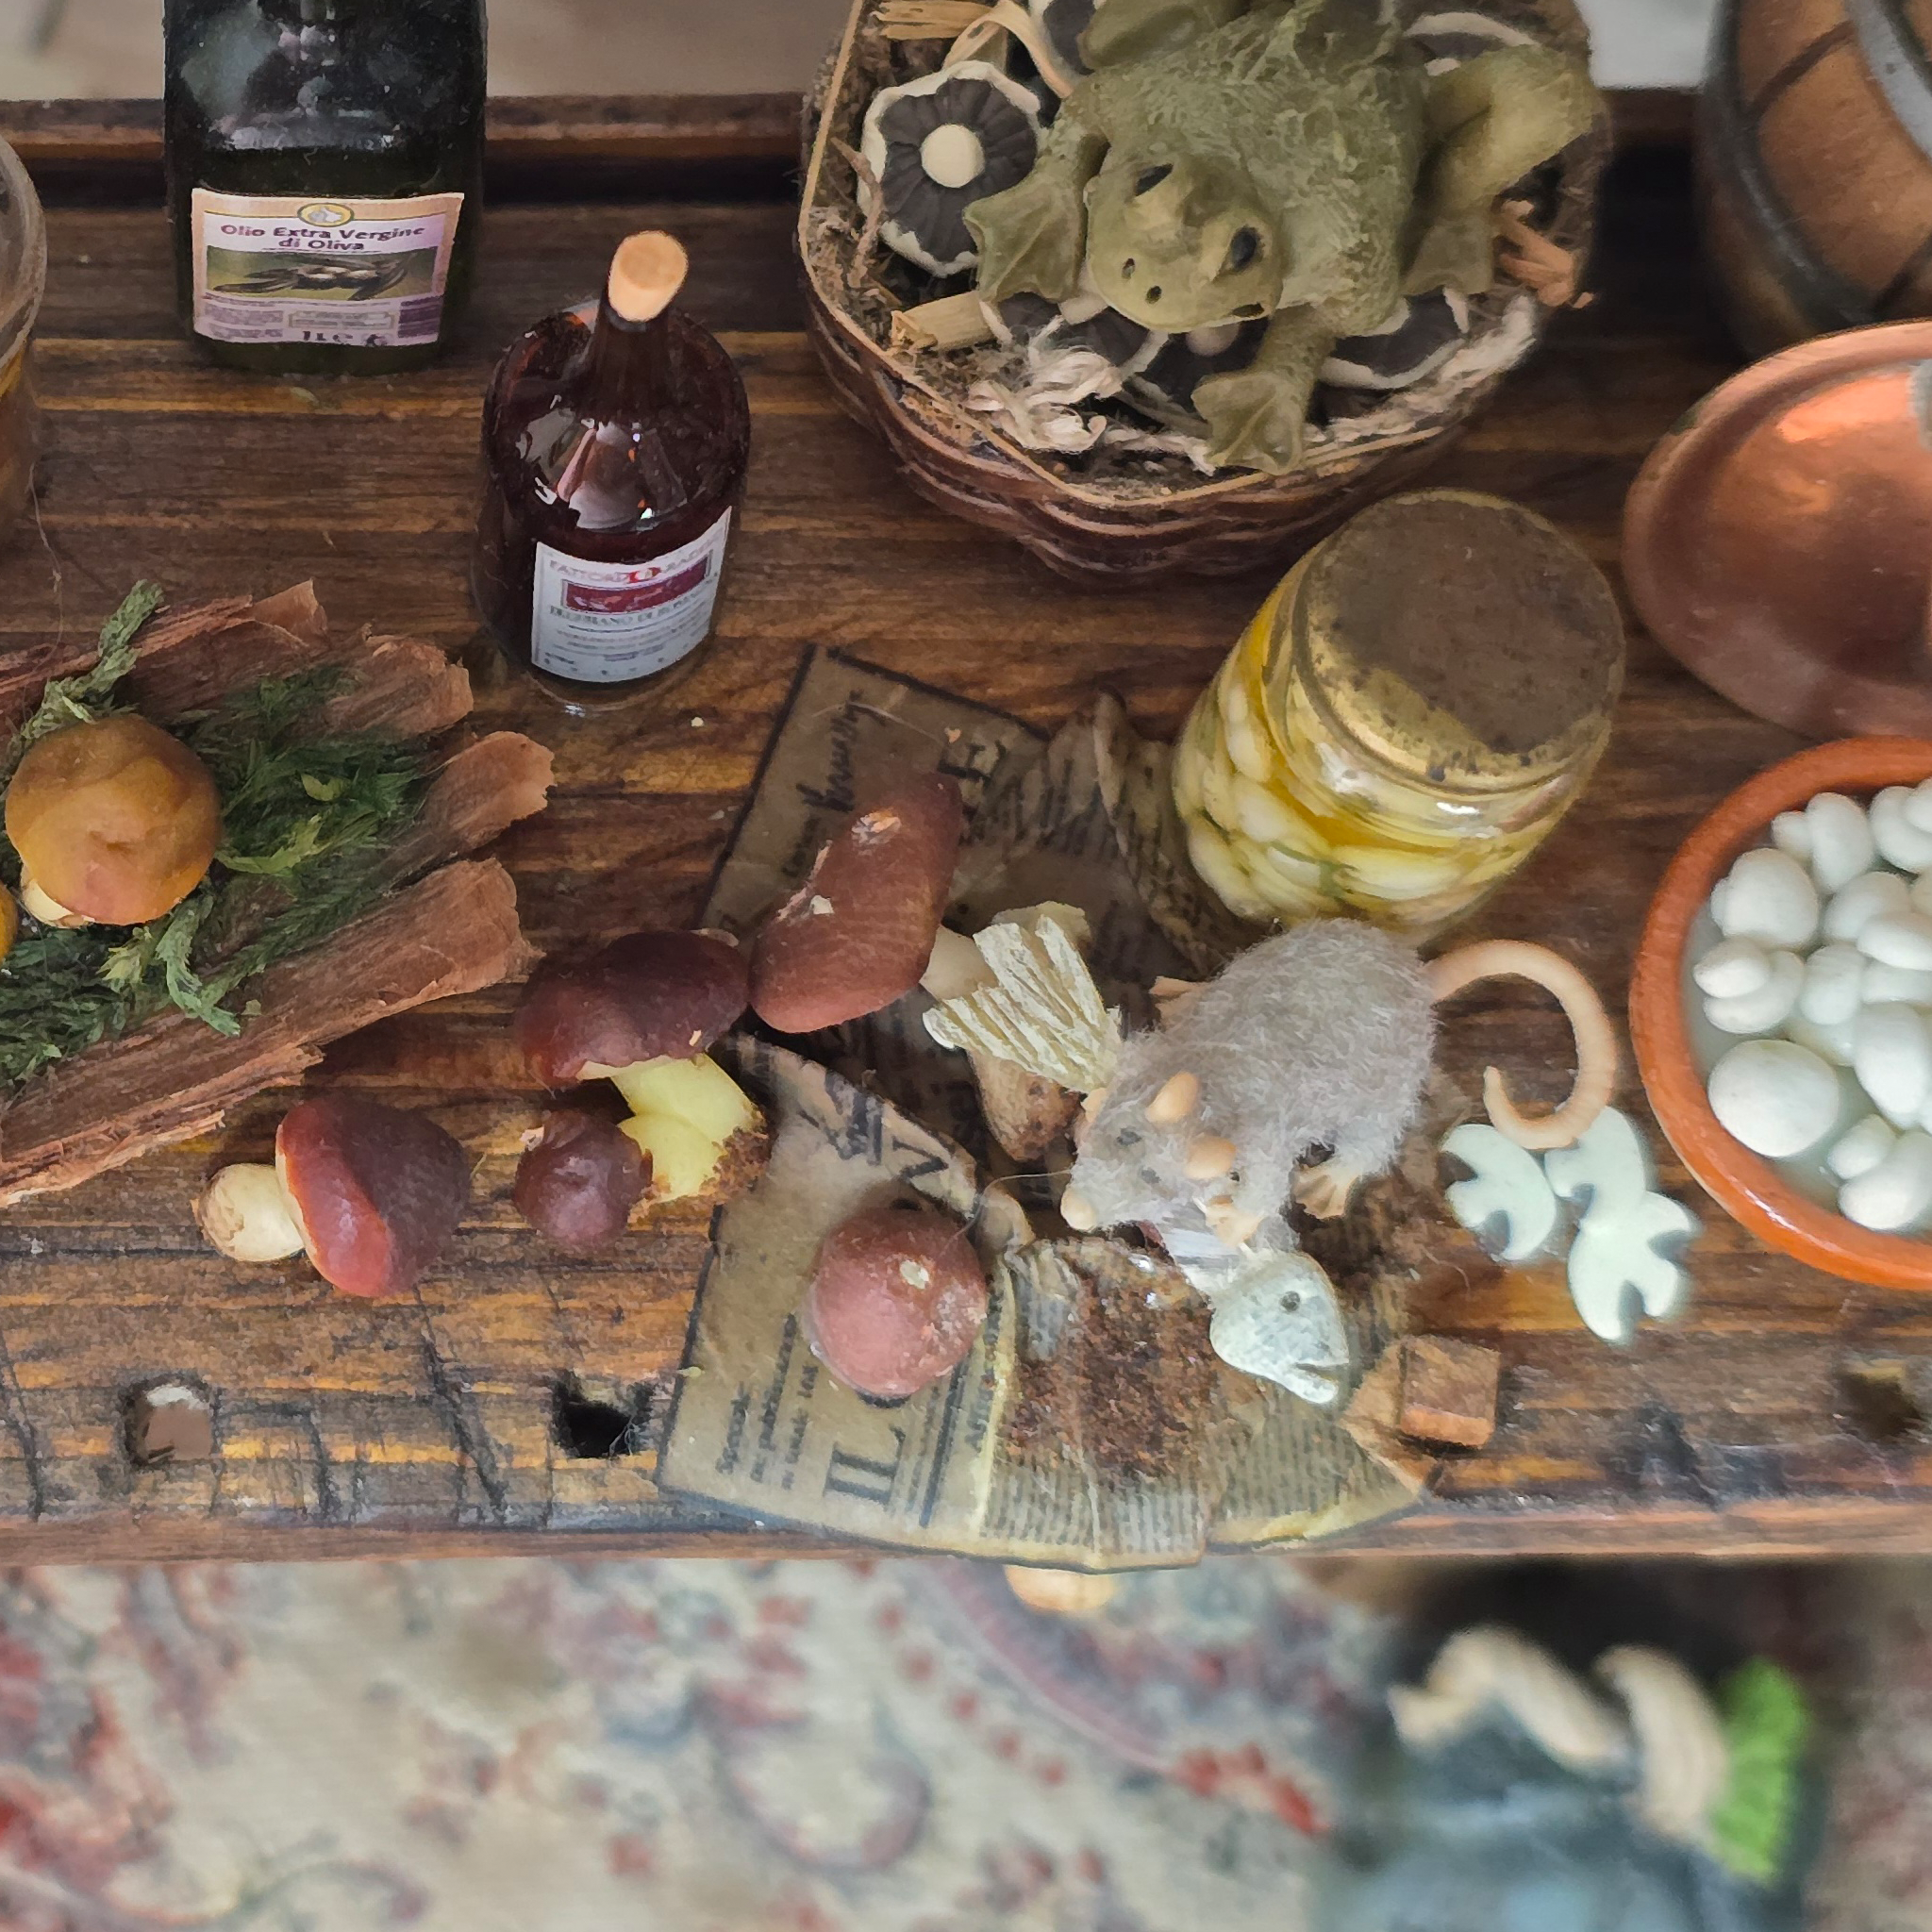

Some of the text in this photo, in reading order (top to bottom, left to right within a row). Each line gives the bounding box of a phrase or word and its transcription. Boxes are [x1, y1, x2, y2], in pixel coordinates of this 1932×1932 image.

[220, 224, 425, 242] Olio Extra Vergine
[278, 237, 364, 251] di Oliva
